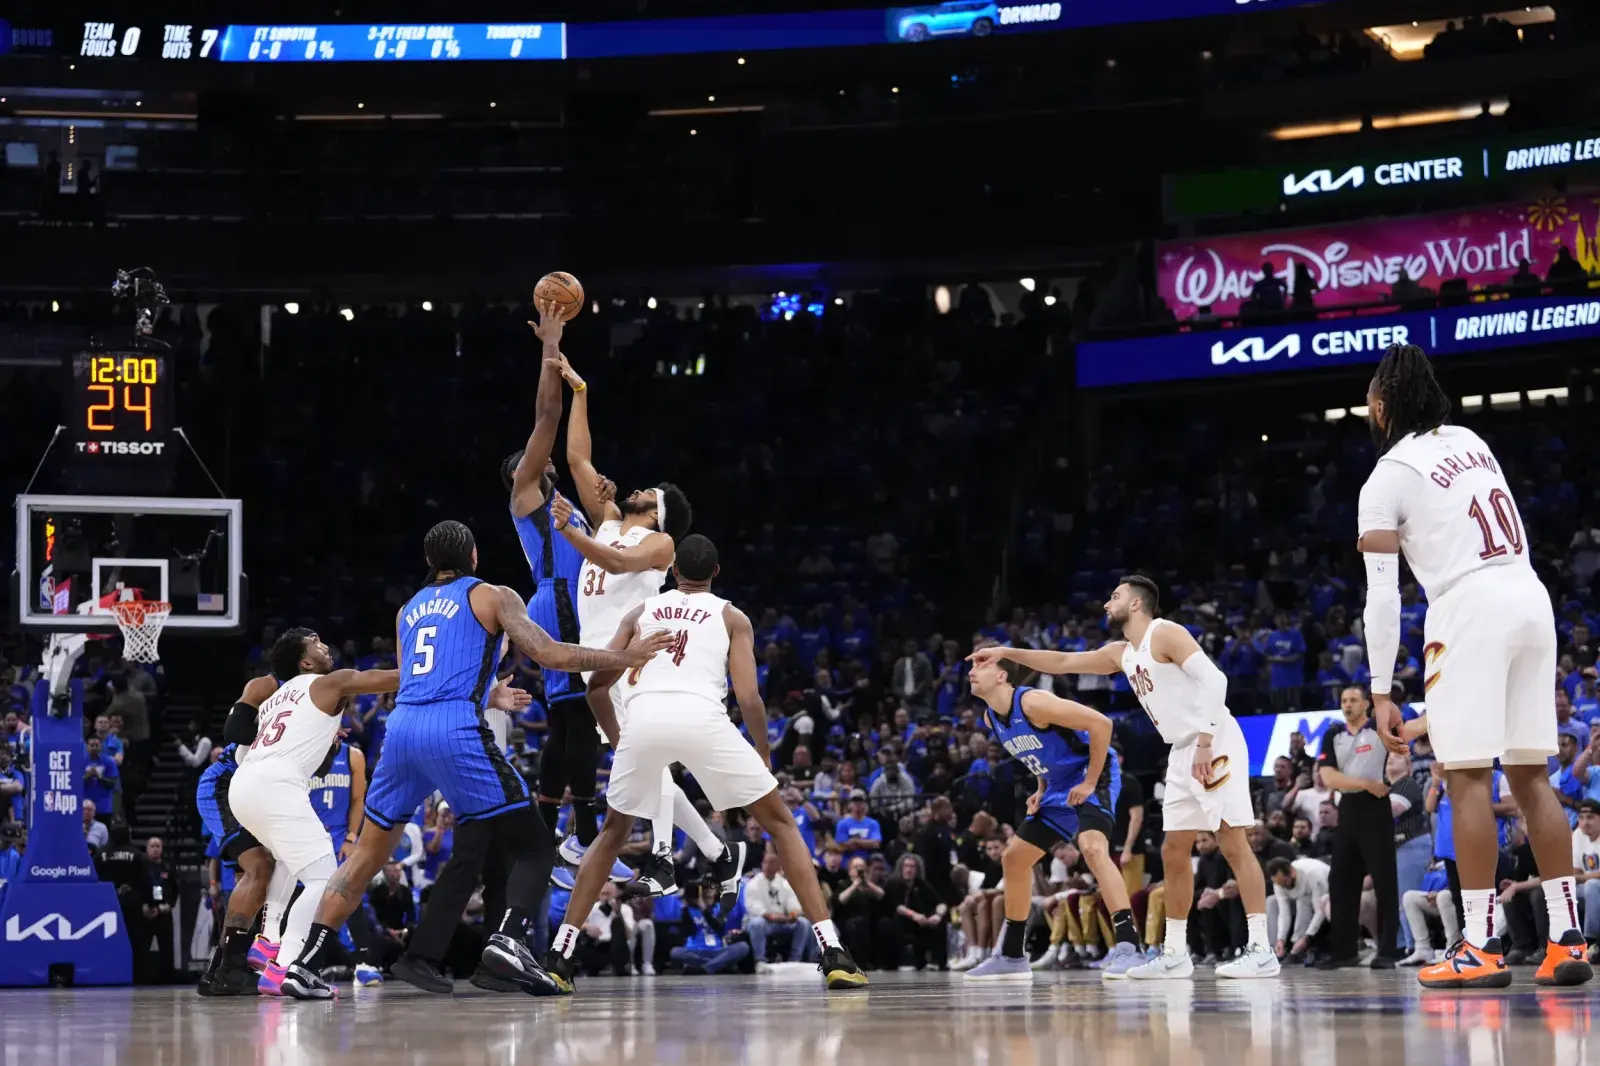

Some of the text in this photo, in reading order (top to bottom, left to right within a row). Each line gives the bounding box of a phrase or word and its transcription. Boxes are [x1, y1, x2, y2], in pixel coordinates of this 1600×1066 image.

[998, 3, 1061, 24] ORWARD
[12, 28, 52, 46] BONUS
[83, 22, 114, 39] TEAM
[120, 27, 141, 55] 0
[164, 25, 192, 41] TIME
[200, 29, 218, 57] 7
[80, 39, 117, 57] FOULS
[162, 42, 192, 58] OUTS
[1505, 142, 1571, 171] DRIVING
[1374, 157, 1463, 185] CENTER
[1424, 228, 1531, 274] World
[1455, 301, 1600, 340] DRIVING LEGEND
[1312, 325, 1409, 356] CENTER
[91, 357, 157, 384] 12:00
[87, 385, 152, 431] 24
[100, 442, 165, 455] TISSOT
[1430, 451, 1498, 489] GARLAND
[1468, 488, 1523, 561] 10
[583, 568, 607, 596] 31
[405, 598, 460, 628] BANCHERO
[652, 606, 712, 624] MOBLEY
[411, 625, 438, 676] 5
[260, 689, 306, 719] MITCHELL
[251, 710, 293, 750] 45
[1003, 734, 1044, 756] RLANDO
[49, 751, 71, 771] GET
[1020, 754, 1049, 776] 22
[49, 771, 72, 790] THE
[55, 791, 77, 814] App
[323, 790, 334, 809] 4
[101, 850, 134, 862] SURITY
[31, 865, 90, 878] Google Pixel
